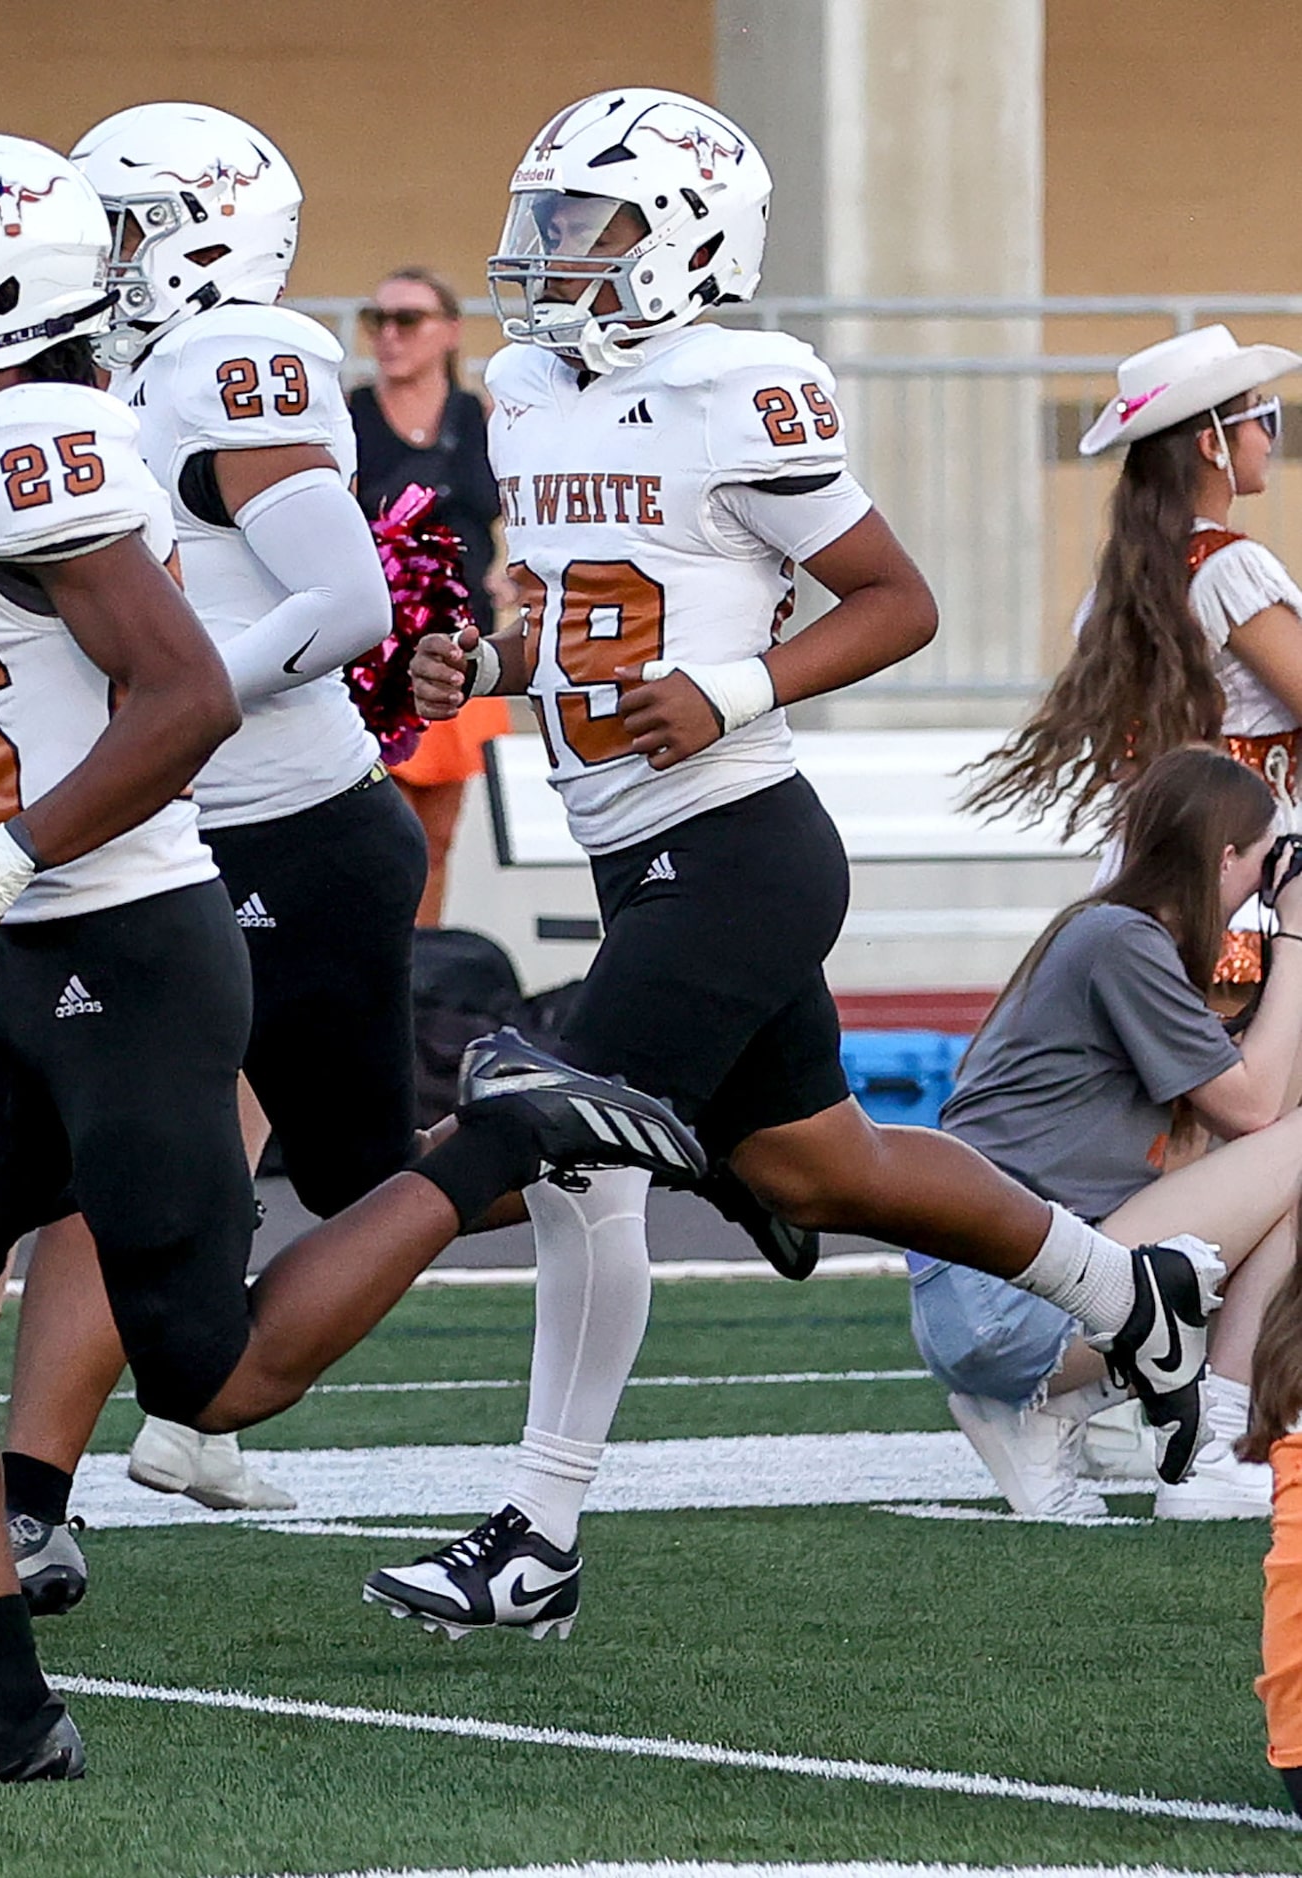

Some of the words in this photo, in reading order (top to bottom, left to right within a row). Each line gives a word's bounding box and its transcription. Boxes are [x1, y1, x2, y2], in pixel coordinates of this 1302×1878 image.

[217, 354, 309, 420] 23
[753, 382, 839, 446] 29
[0, 430, 105, 512] 25
[533, 473, 665, 525] WHITE
[55, 1000, 103, 1018] adidas
